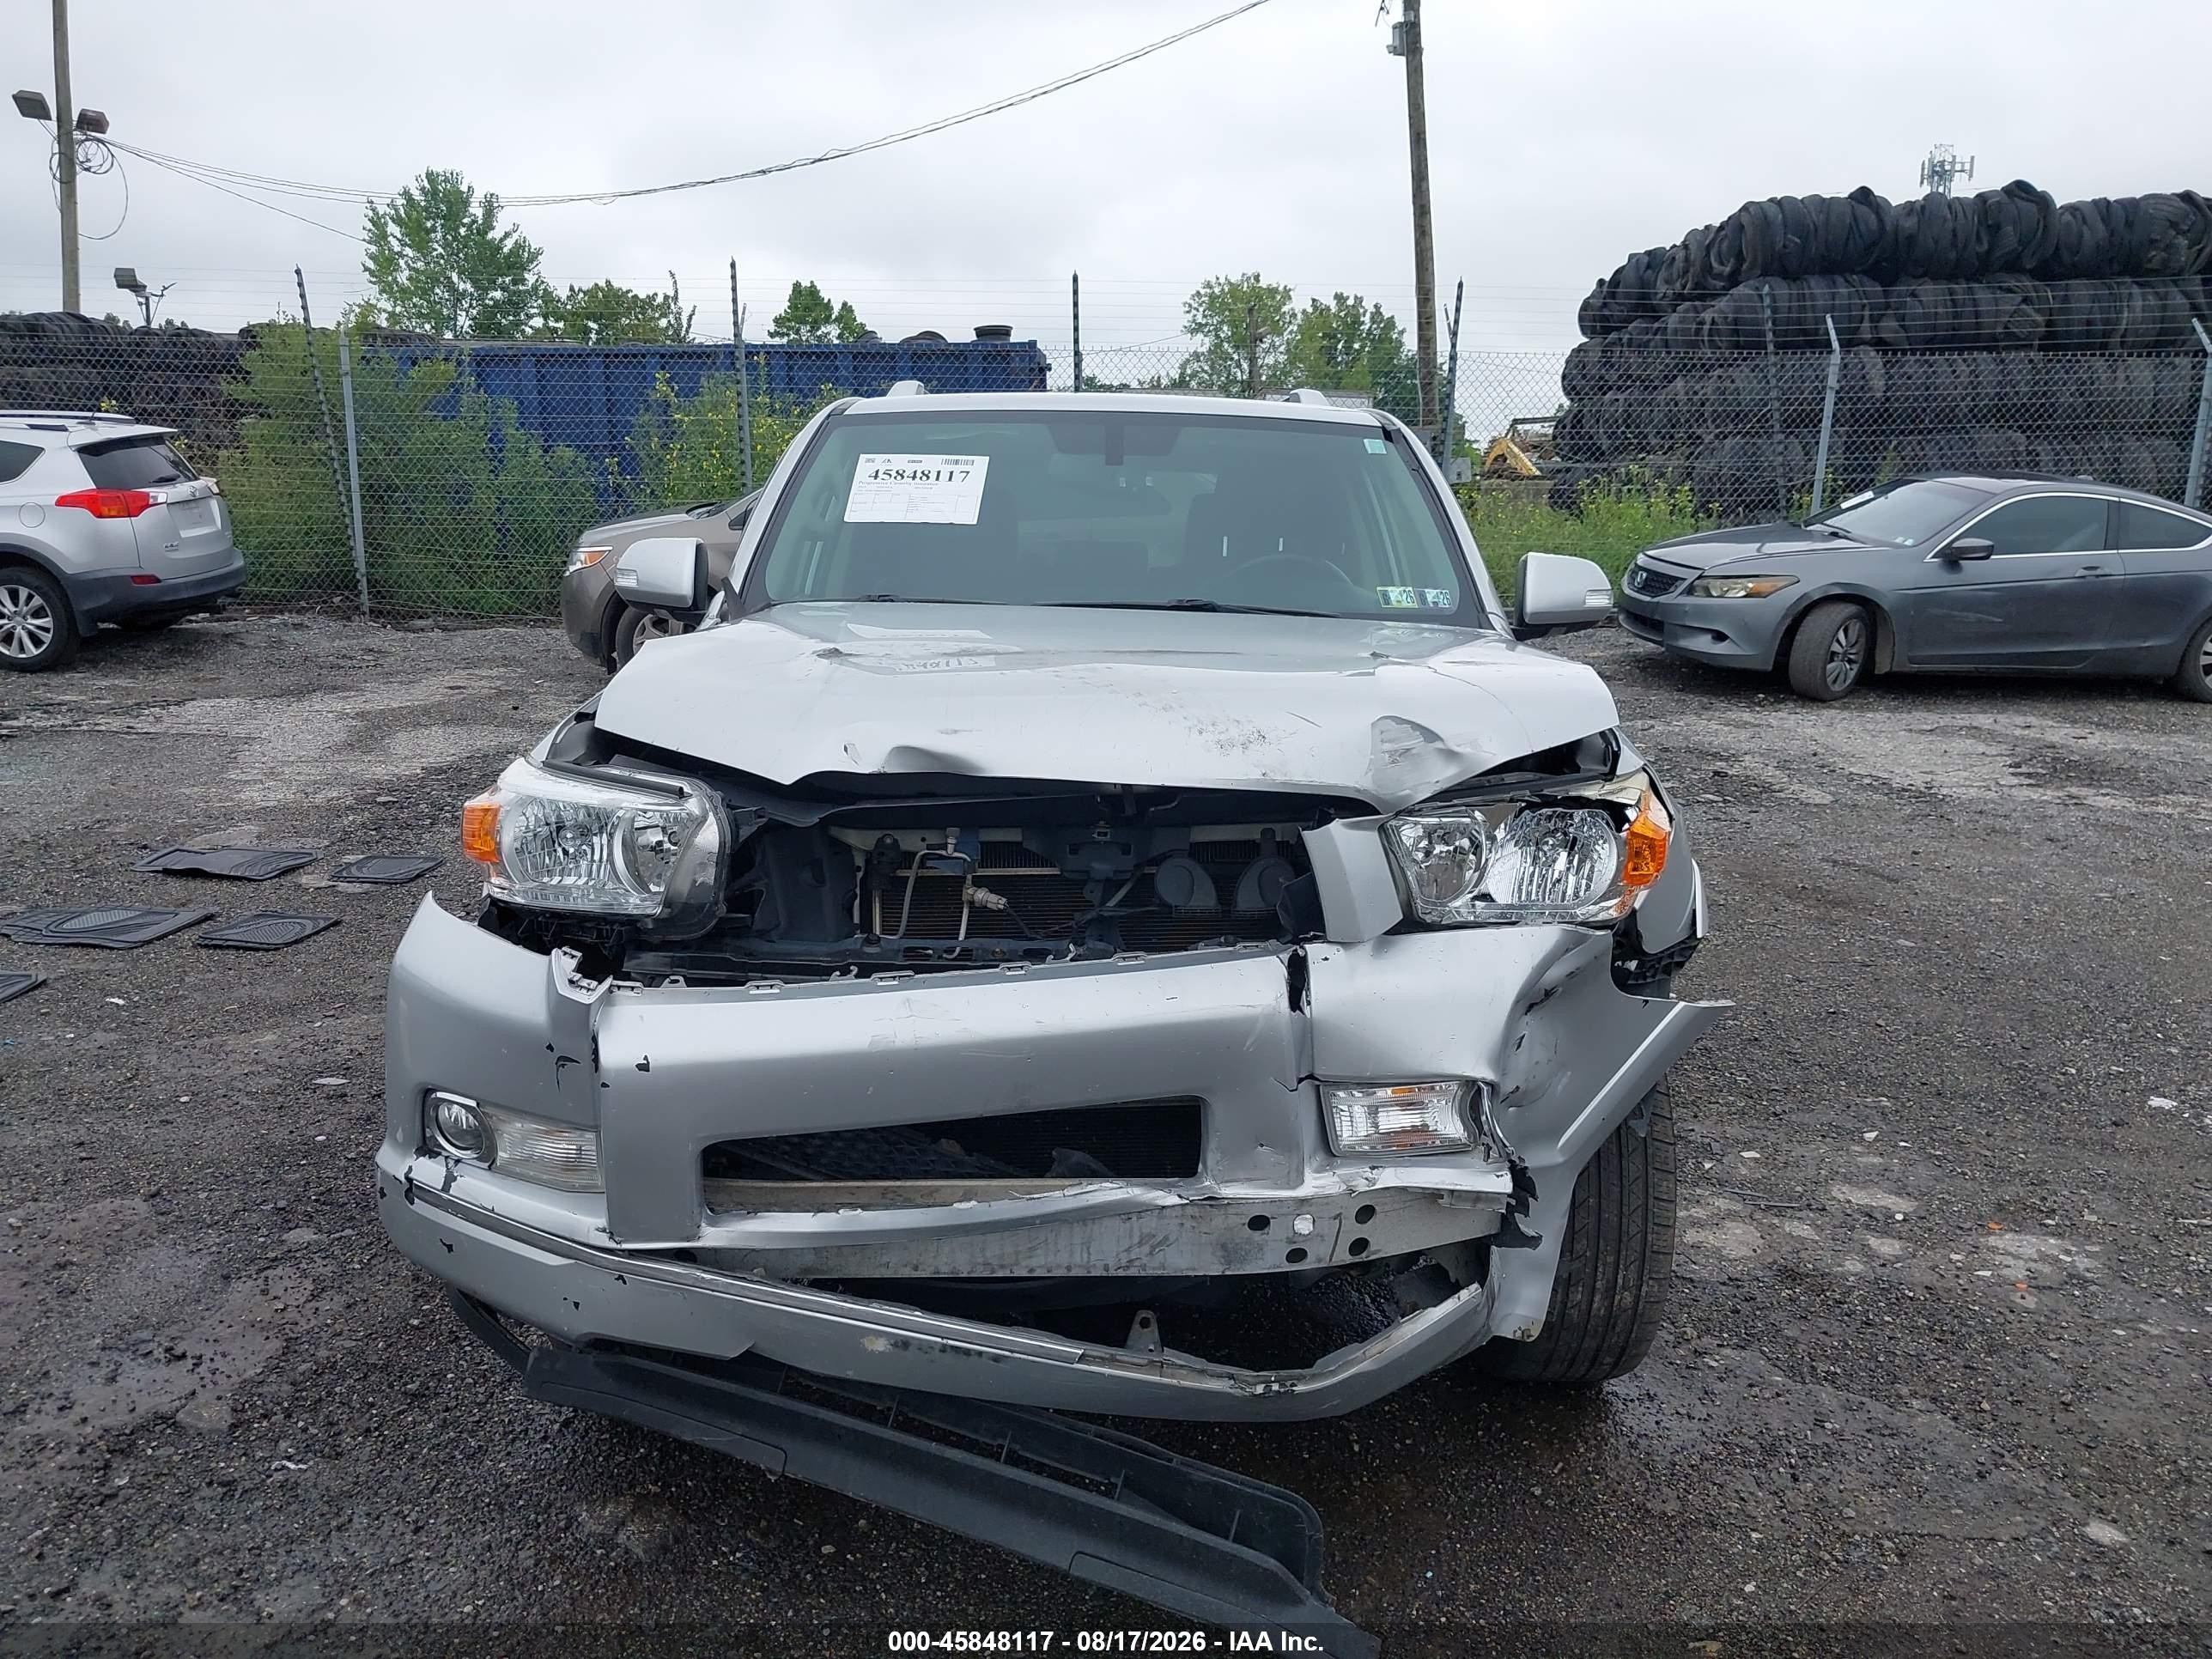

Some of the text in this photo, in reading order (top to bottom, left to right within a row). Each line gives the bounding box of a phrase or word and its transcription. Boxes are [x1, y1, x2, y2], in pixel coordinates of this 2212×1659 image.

[868, 468, 970, 483] 45848117
[1403, 589, 1415, 605] 26
[1440, 591, 1451, 605] 26
